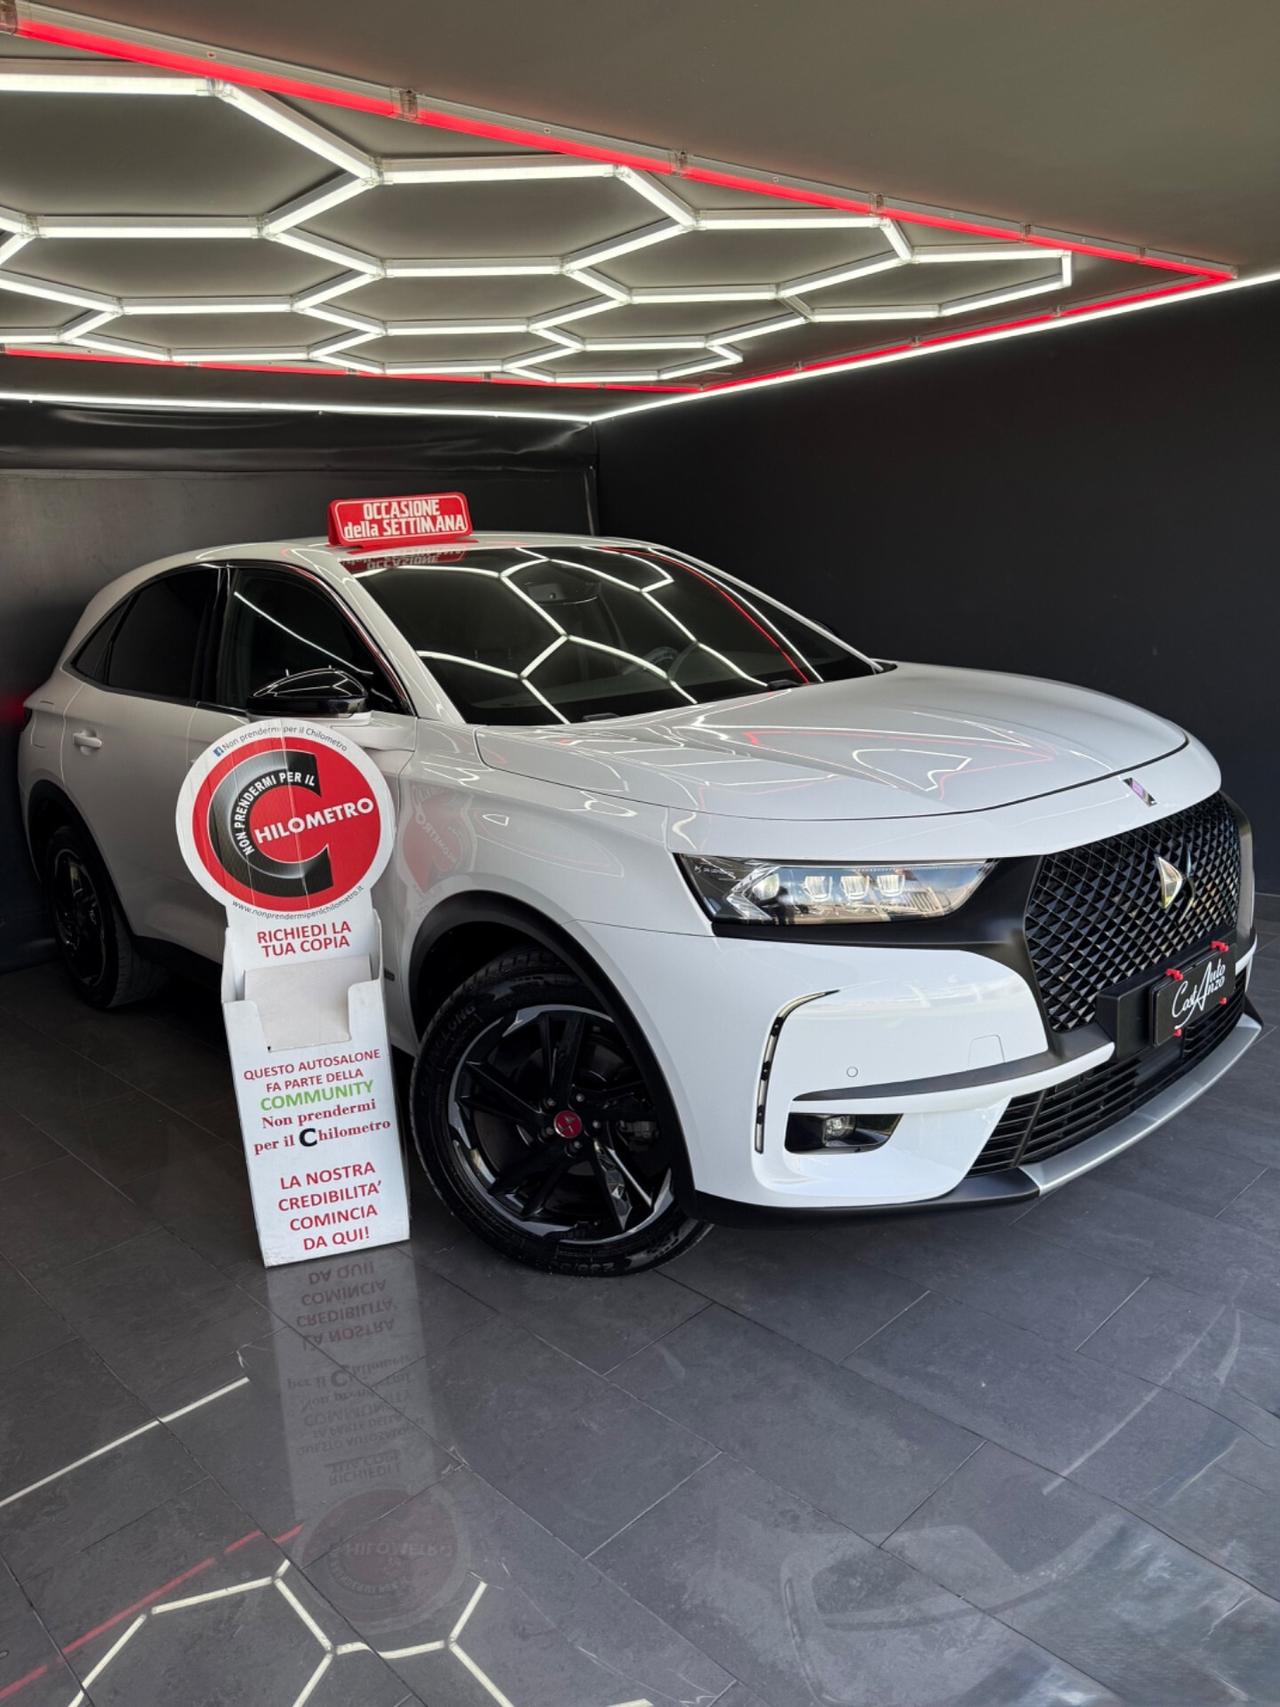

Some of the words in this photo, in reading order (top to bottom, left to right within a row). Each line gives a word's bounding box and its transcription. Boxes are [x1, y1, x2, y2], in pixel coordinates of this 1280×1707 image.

[363, 499, 440, 520] OCCASIONE
[344, 522, 378, 539] della
[383, 515, 465, 536] SETTIMANA
[222, 738, 240, 751] Non
[283, 726, 297, 734] per
[305, 728, 348, 752] Chilometro
[279, 772, 301, 783] PER
[304, 774, 316, 787] IL
[234, 775, 277, 828] PRENDERMI
[235, 831, 255, 856] NON
[257, 923, 327, 944] RICHIEDI
[332, 921, 352, 935] LA
[261, 943, 296, 957] TUA
[300, 935, 350, 953] COPIA
[243, 1063, 295, 1081] QUESTO
[298, 1049, 381, 1071] AUTOSALONE
[266, 1082, 282, 1093] FA
[284, 1076, 324, 1090] PARTE
[326, 1068, 364, 1083] DELLA
[260, 1080, 375, 1111] COMMUNITY
[261, 1114, 293, 1129] Non
[297, 1099, 377, 1127] prendermi
[254, 1139, 280, 1155] per
[284, 1135, 295, 1148] il
[299, 1120, 391, 1147] Chilometro
[280, 1175, 301, 1190] LA
[306, 1161, 376, 1185] NOSTRA
[289, 1204, 378, 1231] COMINCIA
[303, 1235, 328, 1251] DA
[331, 1226, 370, 1246] QUI!
